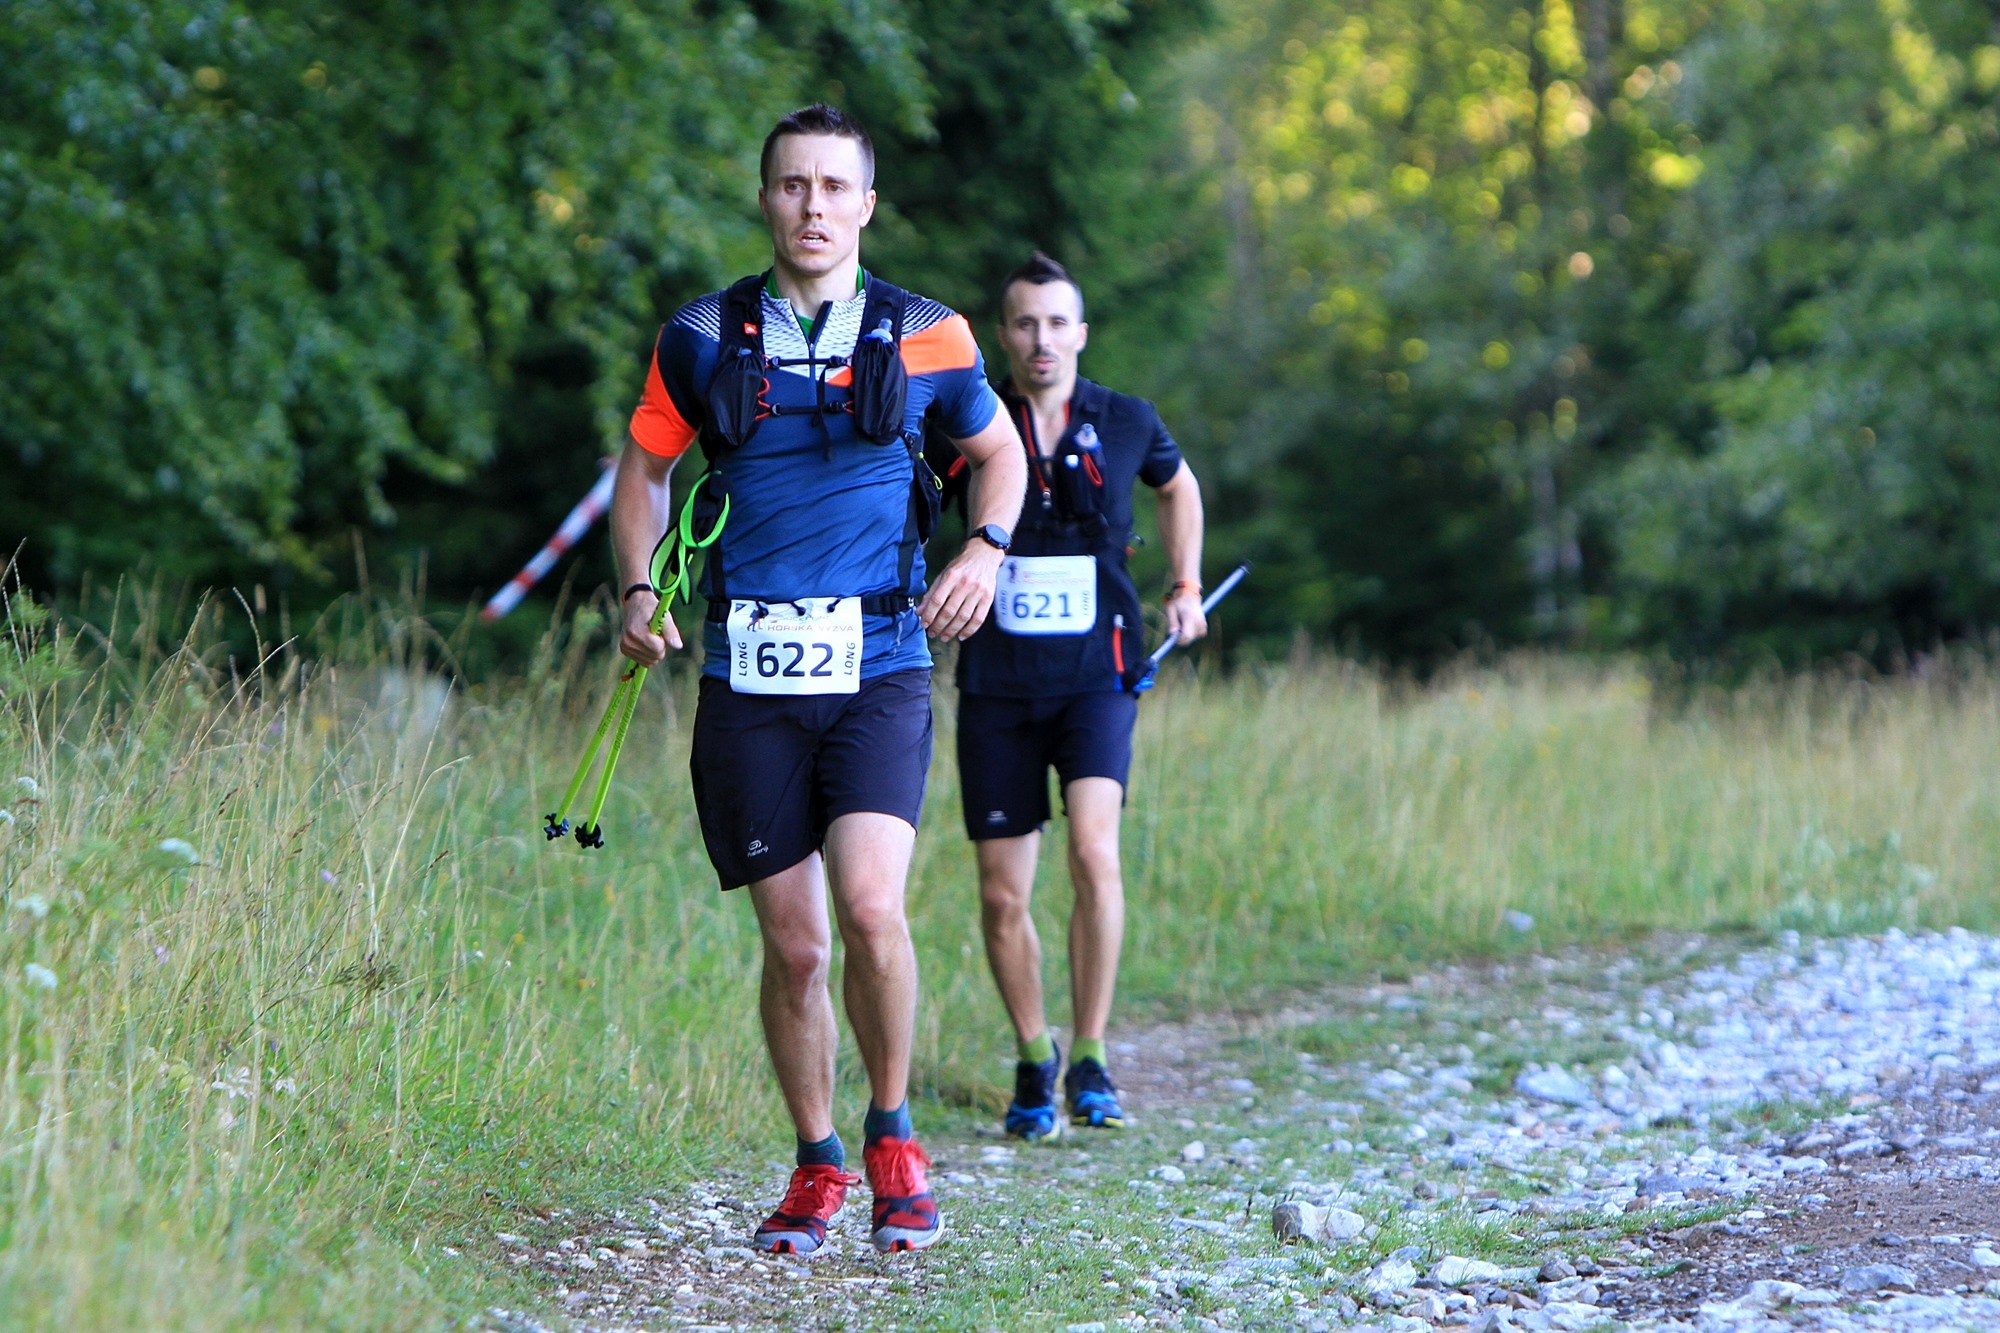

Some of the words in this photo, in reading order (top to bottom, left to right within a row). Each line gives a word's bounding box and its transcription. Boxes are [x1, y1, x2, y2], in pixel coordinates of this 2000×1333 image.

[1013, 592, 1072, 618] 621
[738, 641, 748, 677] LONG
[757, 642, 833, 677] 622
[844, 642, 855, 675] LONG
